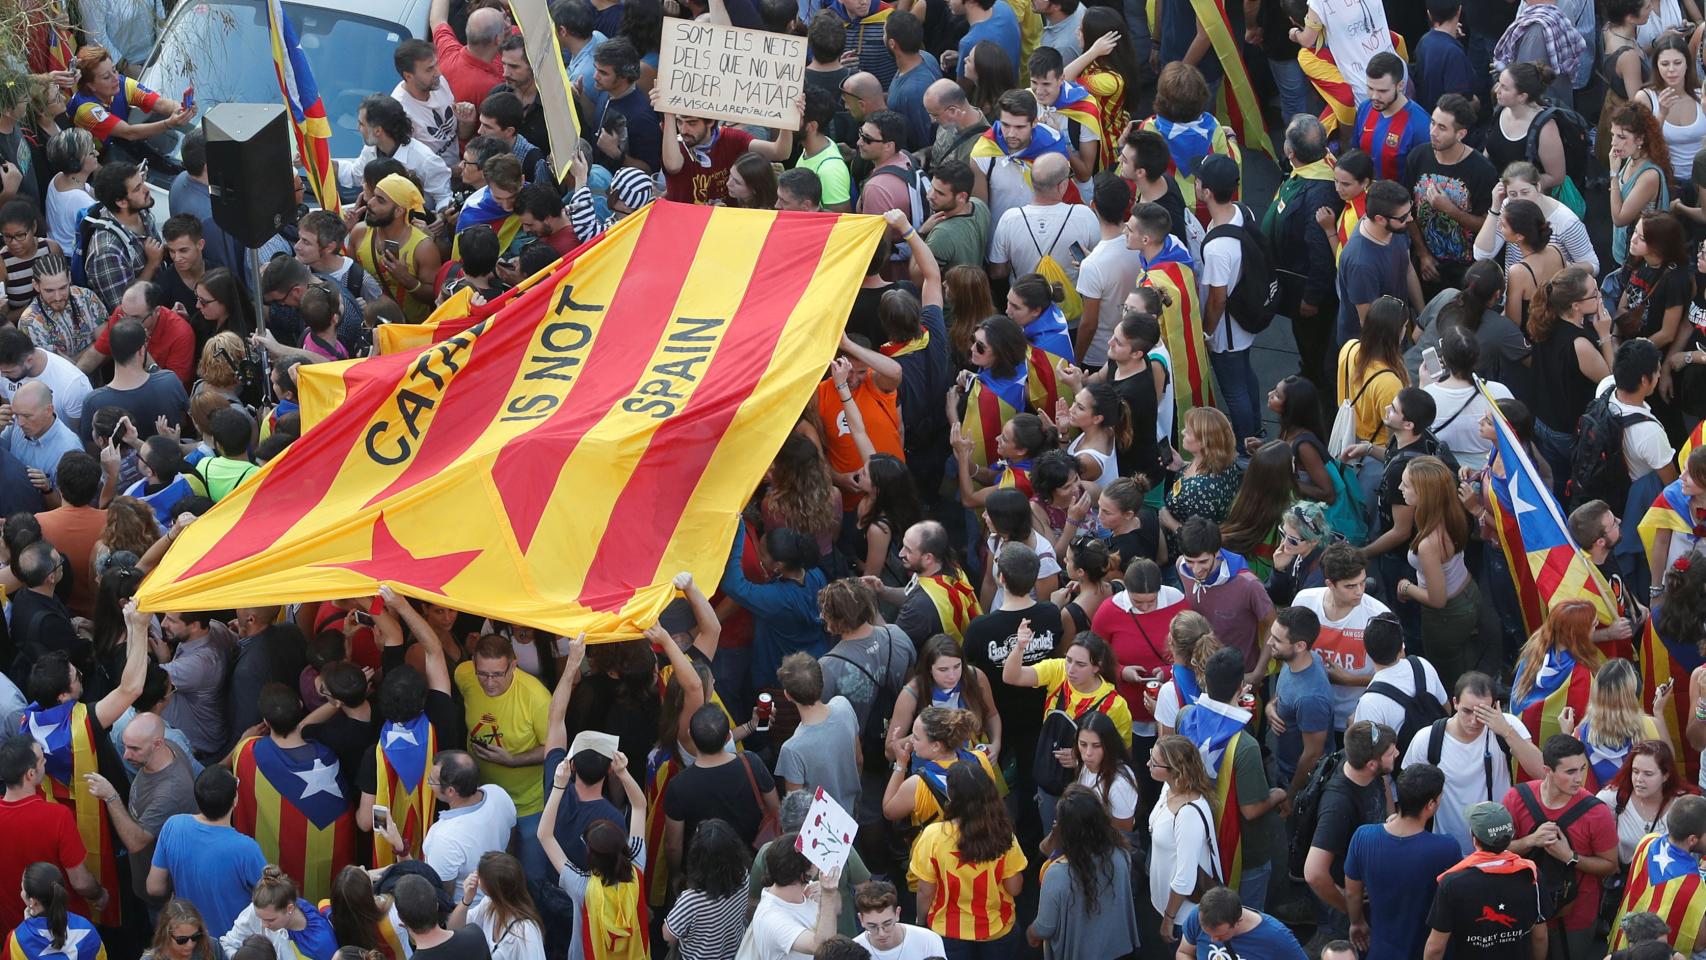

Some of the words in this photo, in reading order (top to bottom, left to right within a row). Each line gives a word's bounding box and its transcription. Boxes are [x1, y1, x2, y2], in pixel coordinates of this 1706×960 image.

[676, 23, 714, 47] SOM
[724, 30, 753, 52] ELS
[763, 36, 800, 58] NETS
[673, 45, 711, 69] DELS
[719, 52, 744, 76] QUE
[749, 57, 768, 79] NO
[774, 61, 803, 83] VAU
[670, 69, 721, 97] PODER
[733, 78, 799, 109] MATAR
[523, 284, 604, 382] NOT
[622, 317, 726, 419] SPAIN
[500, 393, 559, 423] IS
[1467, 933, 1498, 943] JOCKEY
